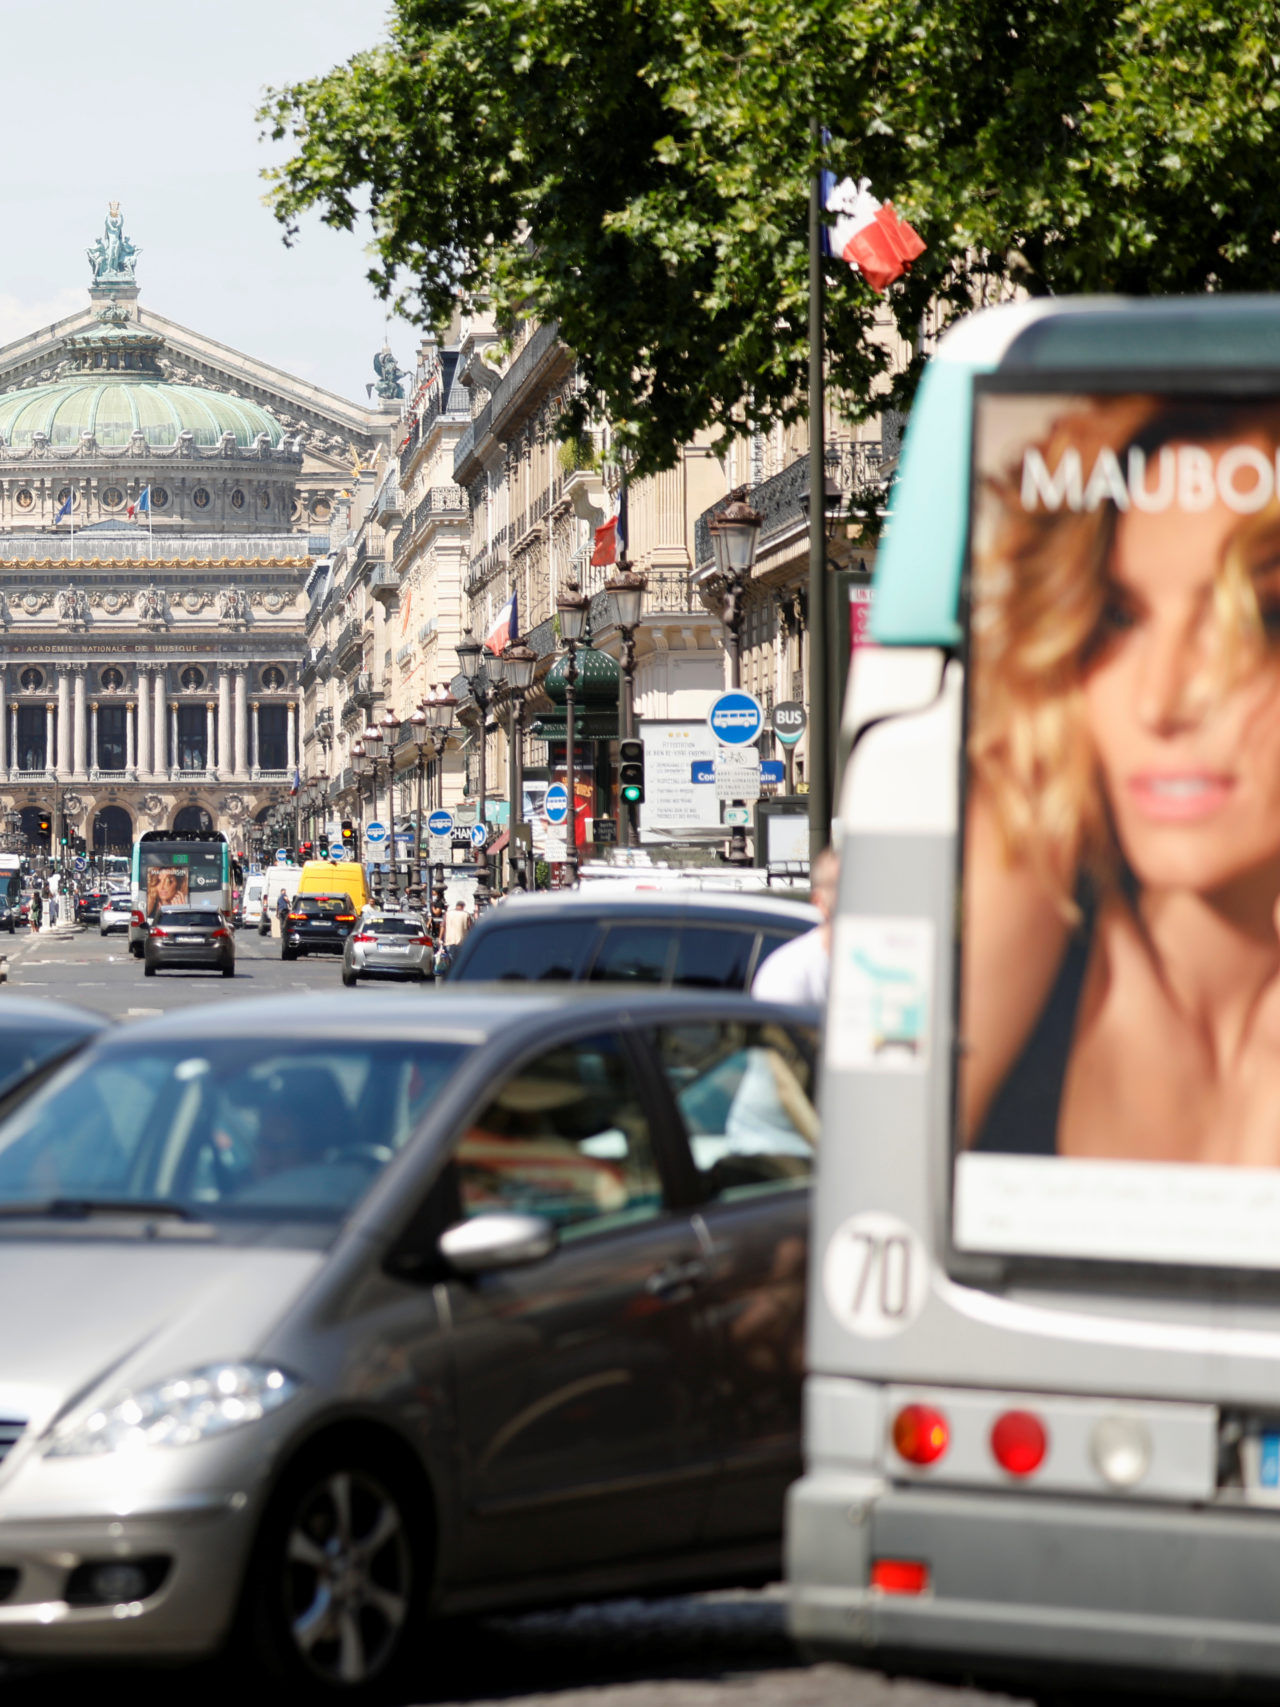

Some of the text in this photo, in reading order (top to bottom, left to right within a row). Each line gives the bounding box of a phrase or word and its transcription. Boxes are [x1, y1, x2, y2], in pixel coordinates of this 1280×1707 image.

[1020, 443, 1280, 515] MAUBO
[26, 645, 198, 653] ACADEMIE NATIONALE DE MUSIQUE
[776, 710, 802, 724] BUS
[851, 1232, 911, 1319] 70
